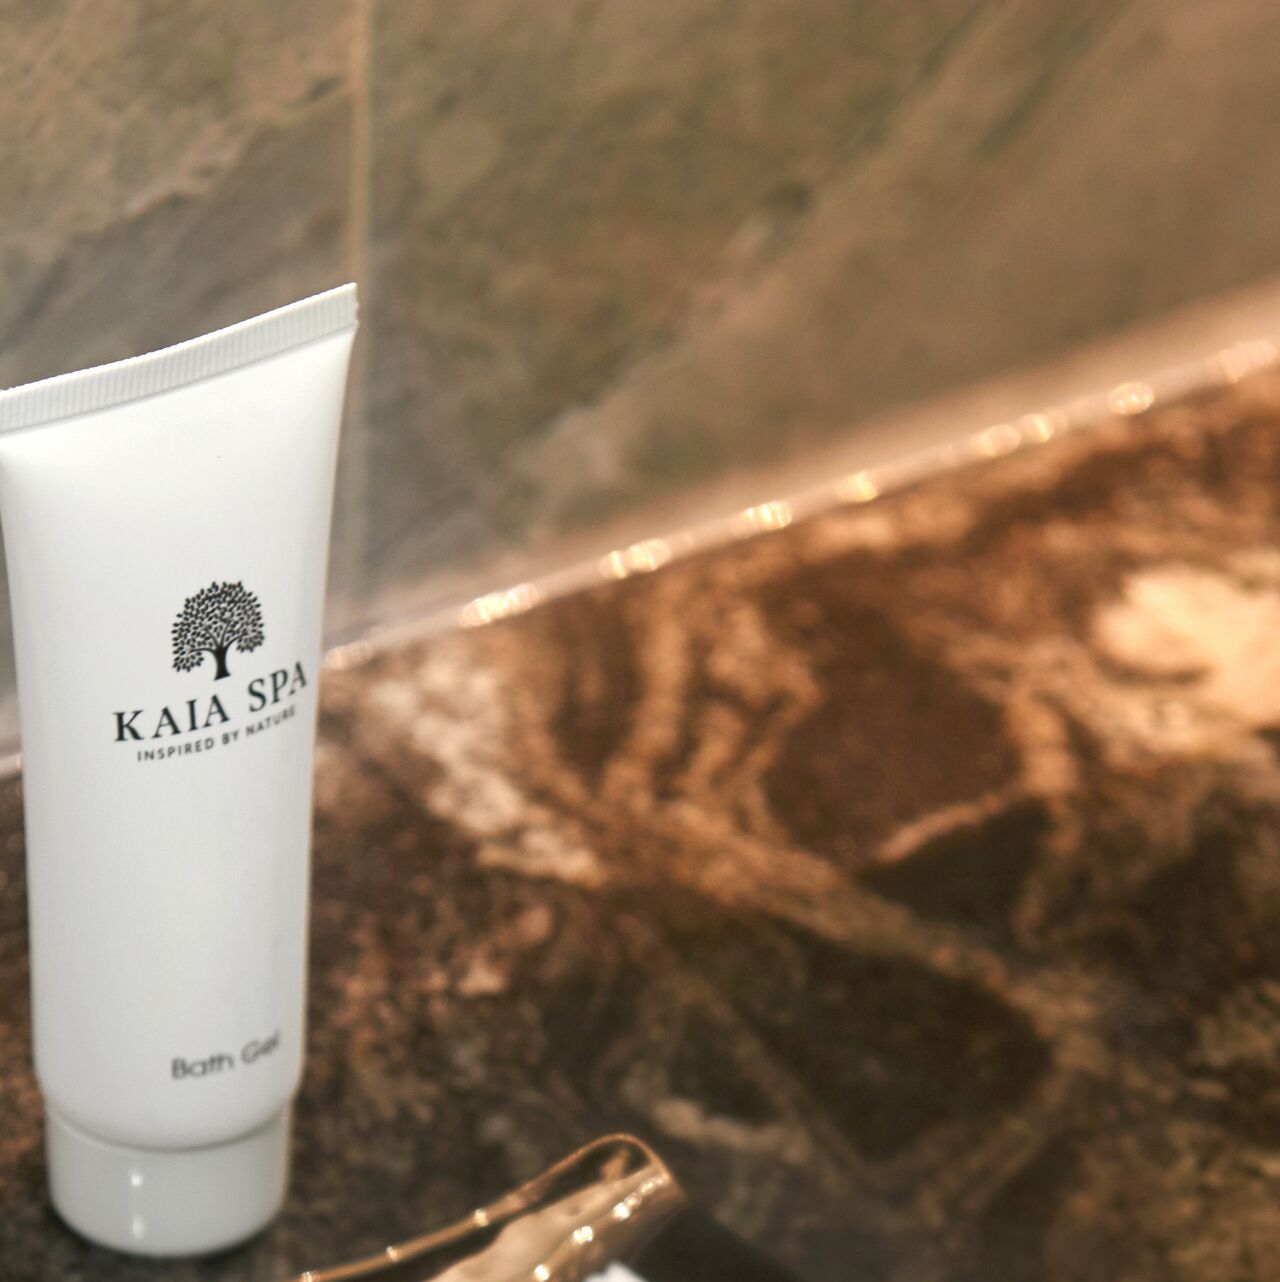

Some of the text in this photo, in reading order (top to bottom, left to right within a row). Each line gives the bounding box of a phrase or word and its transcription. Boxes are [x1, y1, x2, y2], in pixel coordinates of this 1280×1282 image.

[113, 661, 308, 742] KAIA SPA
[137, 704, 296, 762] INSPIRED BY NATURE
[172, 1053, 234, 1079] Bath
